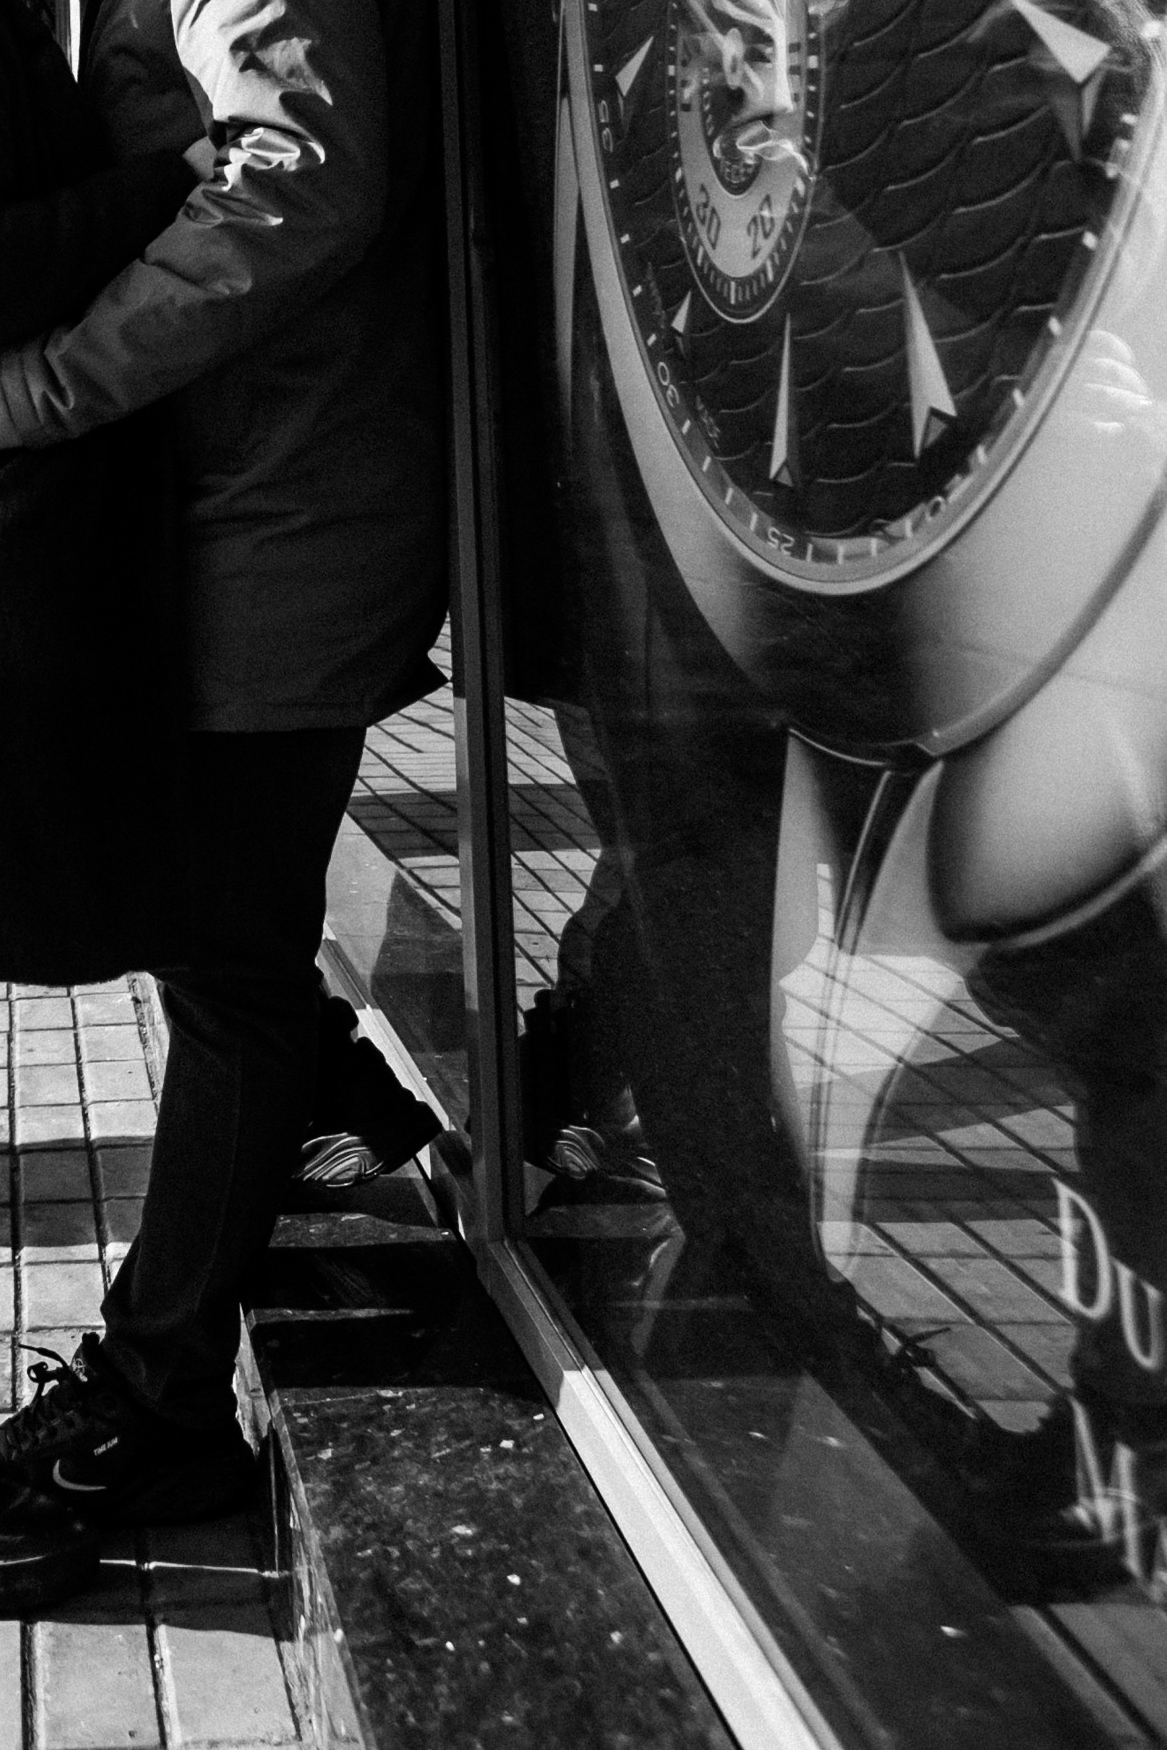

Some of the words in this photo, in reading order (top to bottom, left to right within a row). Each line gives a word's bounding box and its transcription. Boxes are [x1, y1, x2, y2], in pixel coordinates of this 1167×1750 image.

[695, 182, 722, 251] 30
[746, 193, 776, 260] 20
[766, 525, 796, 557] 25
